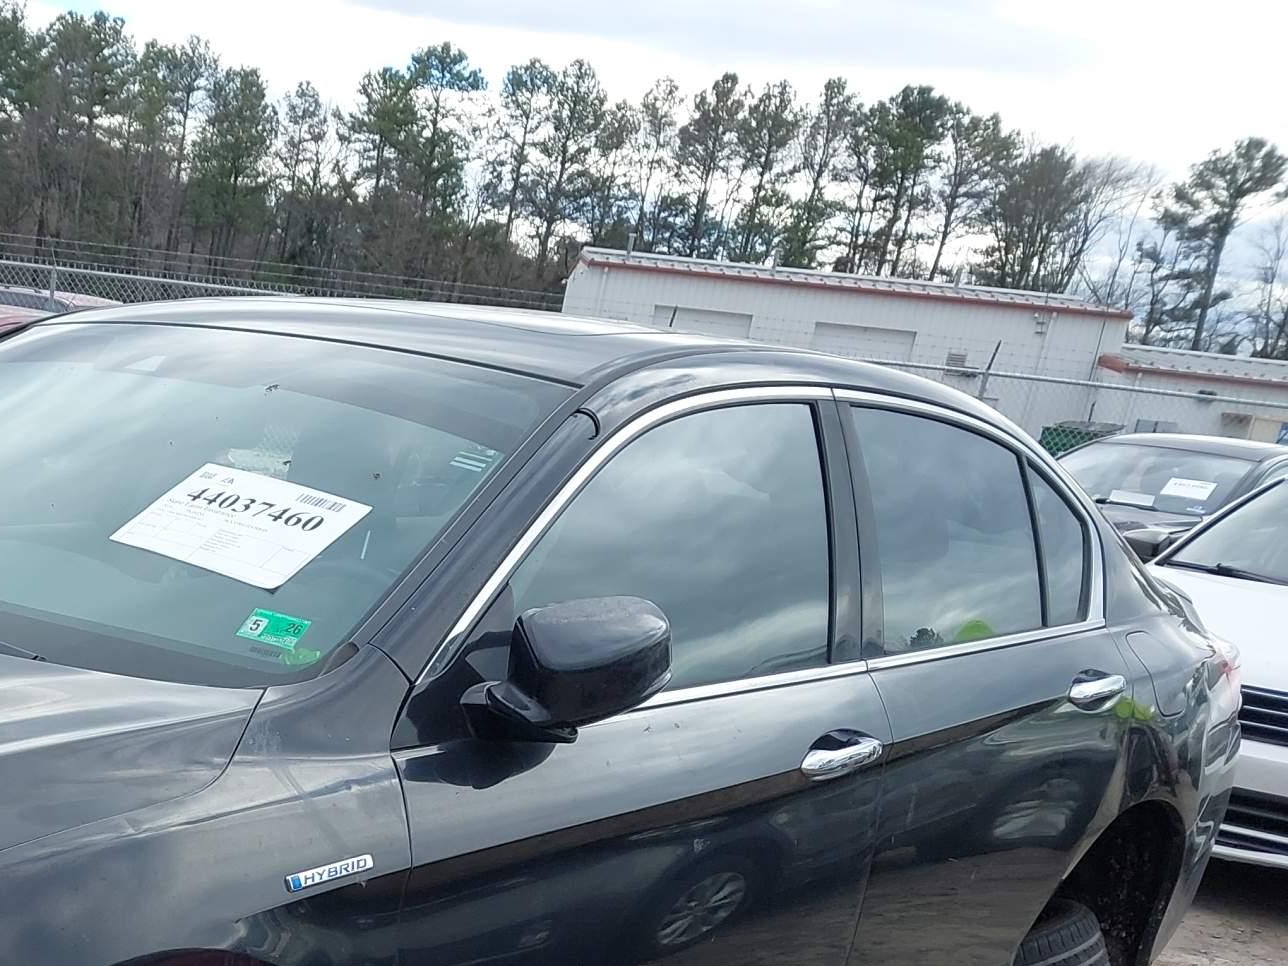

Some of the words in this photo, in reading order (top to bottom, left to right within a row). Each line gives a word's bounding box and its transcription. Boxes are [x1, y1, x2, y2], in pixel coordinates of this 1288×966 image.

[187, 487, 325, 532] 44037460
[249, 619, 263, 632] 5
[286, 623, 303, 635] 26
[303, 858, 367, 885] HYBRID
